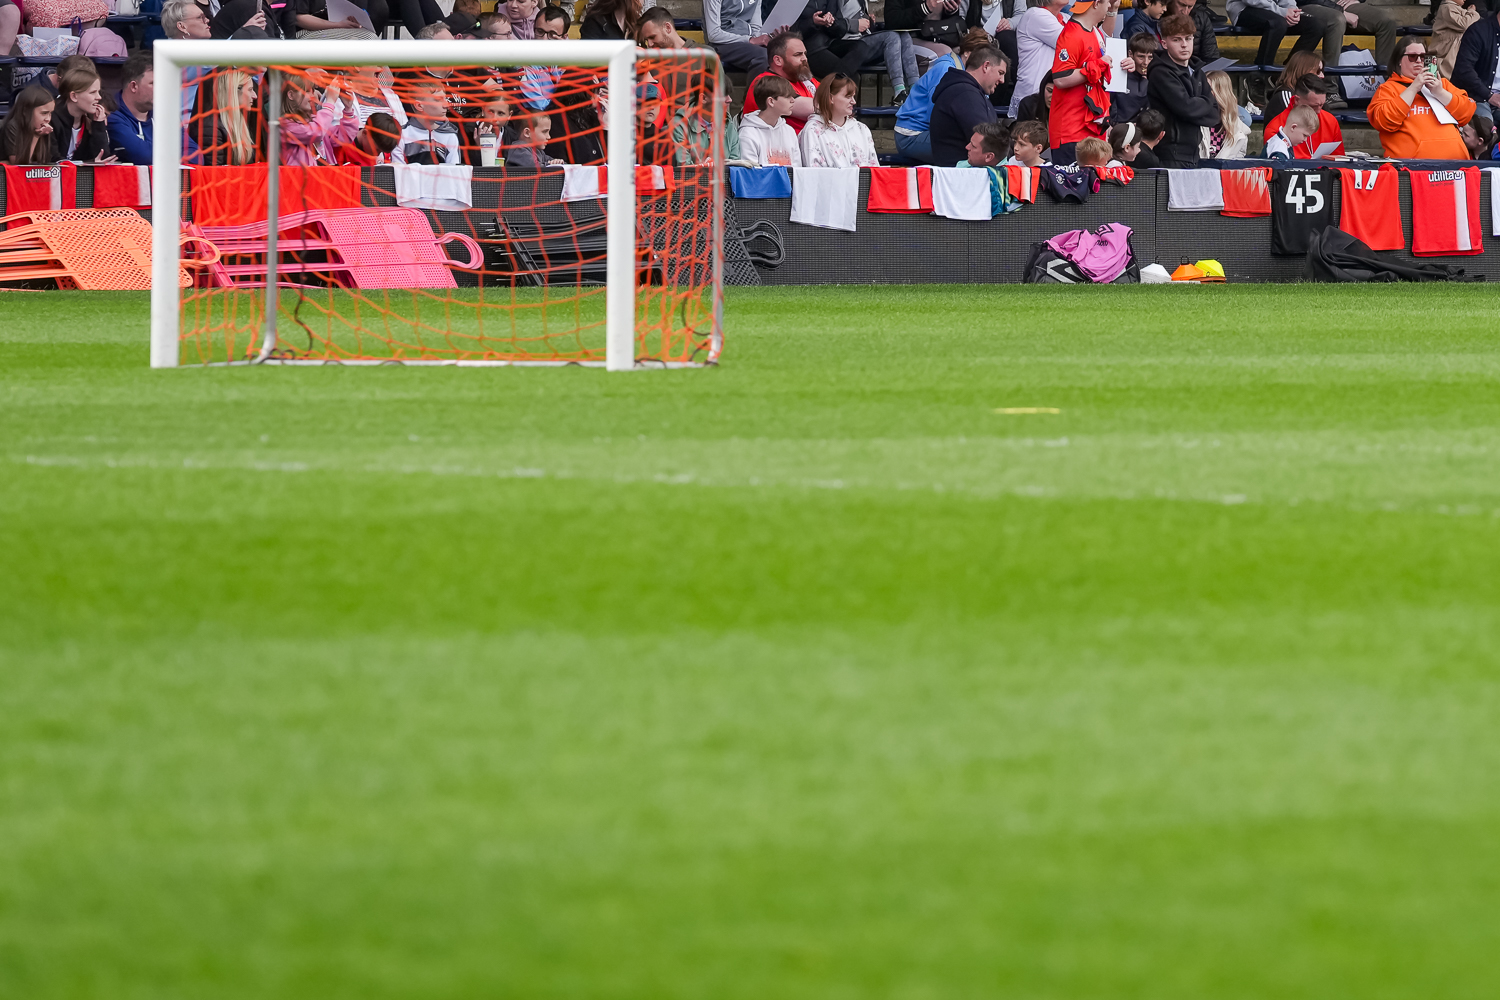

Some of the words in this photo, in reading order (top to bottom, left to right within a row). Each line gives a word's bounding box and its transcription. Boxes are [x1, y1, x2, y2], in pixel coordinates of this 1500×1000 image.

[25, 169, 51, 181] utilita
[1428, 170, 1455, 182] utilita
[1284, 174, 1324, 214] 45
